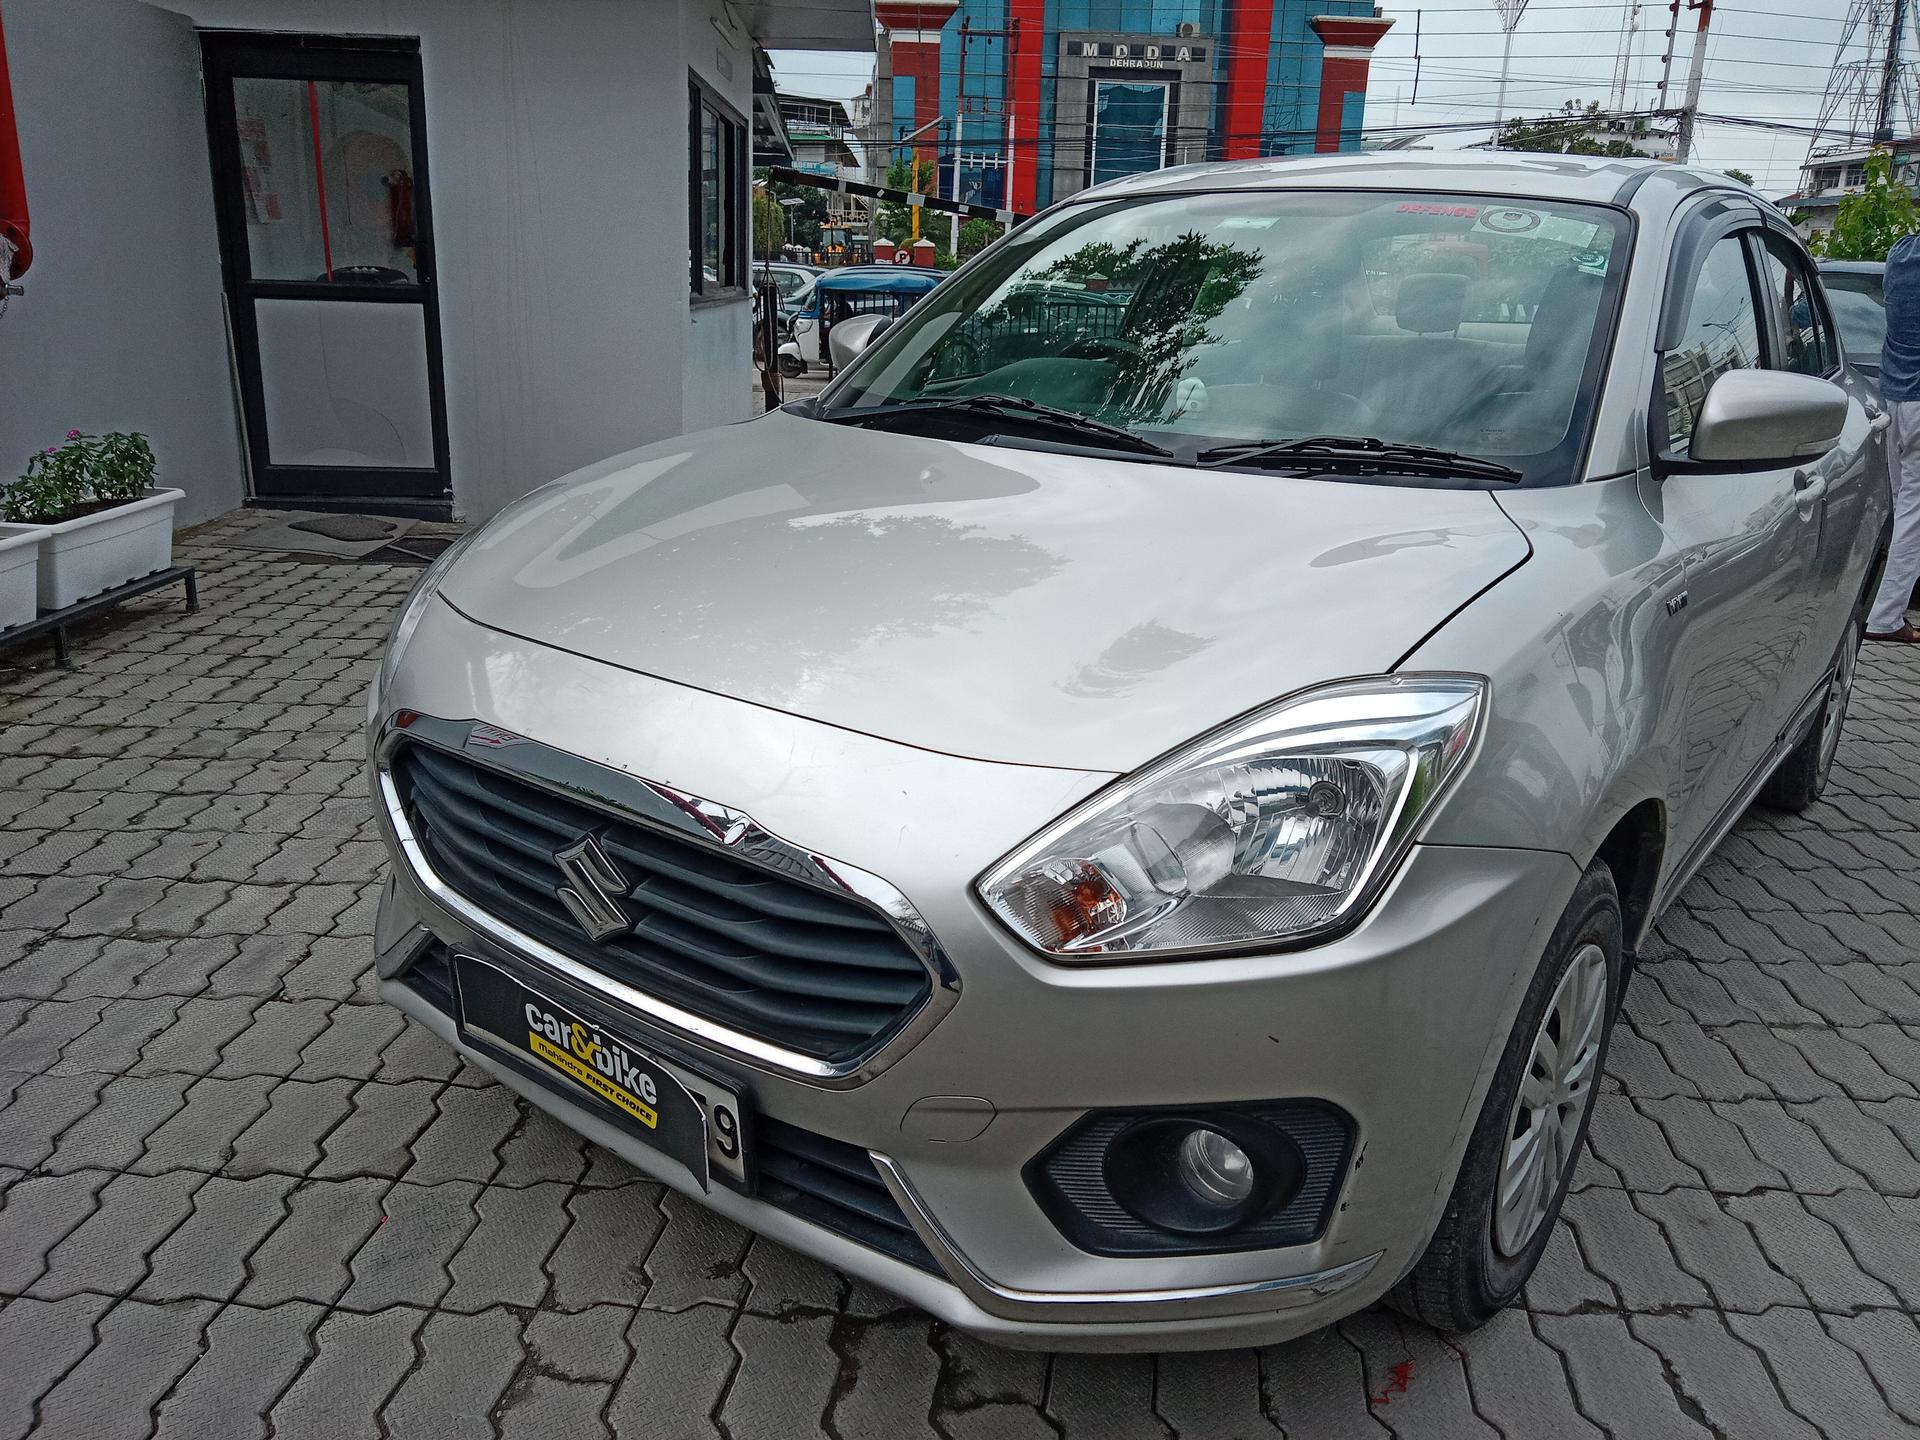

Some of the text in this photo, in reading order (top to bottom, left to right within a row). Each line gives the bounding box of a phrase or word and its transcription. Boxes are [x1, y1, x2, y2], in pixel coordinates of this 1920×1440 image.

[1109, 58, 1164, 69] DEHRADUN
[1395, 203, 1479, 219] DEFENCE
[585, 1073, 615, 1096] FIRST
[616, 1092, 653, 1122] CHOICE
